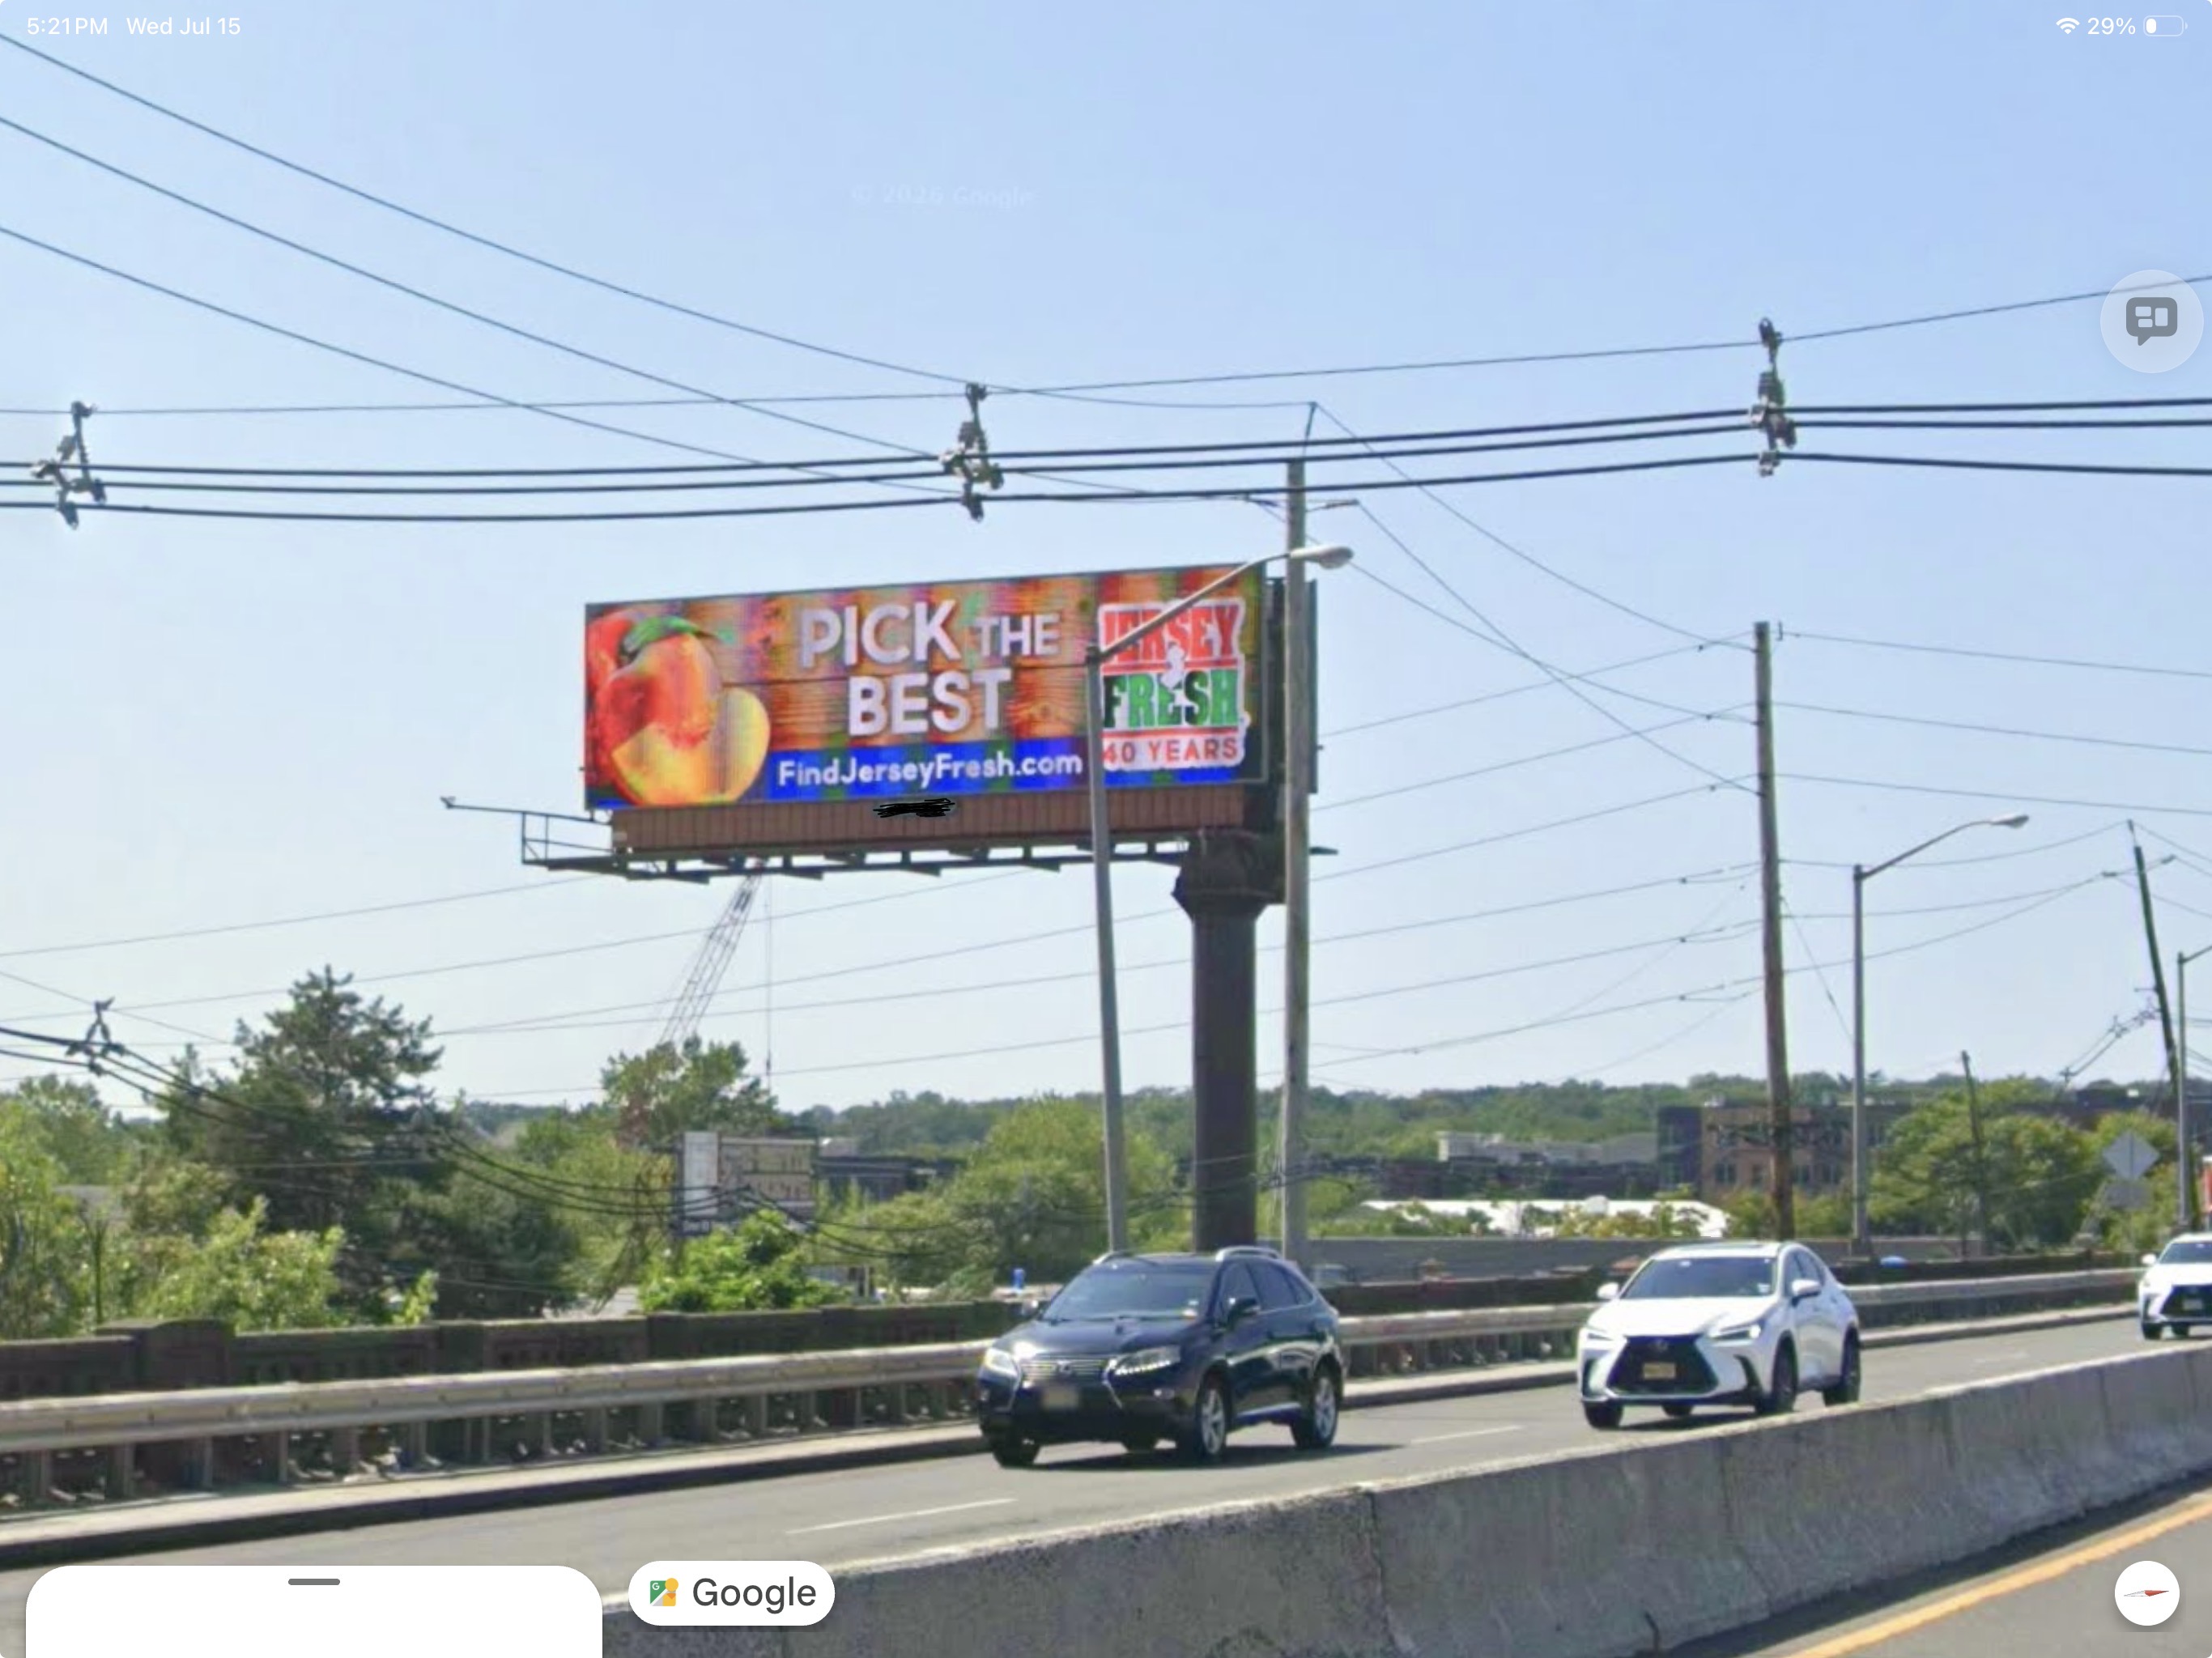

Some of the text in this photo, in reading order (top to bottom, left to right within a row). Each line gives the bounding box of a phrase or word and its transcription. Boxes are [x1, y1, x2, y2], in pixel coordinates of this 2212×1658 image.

[799, 599, 1061, 668] PICK THE
[848, 667, 1012, 737] BEST
[1103, 669, 1239, 728] FRESH
[778, 750, 1083, 789] FindJerseyFresh.com
[1102, 738, 1238, 763] 40 YEARS
